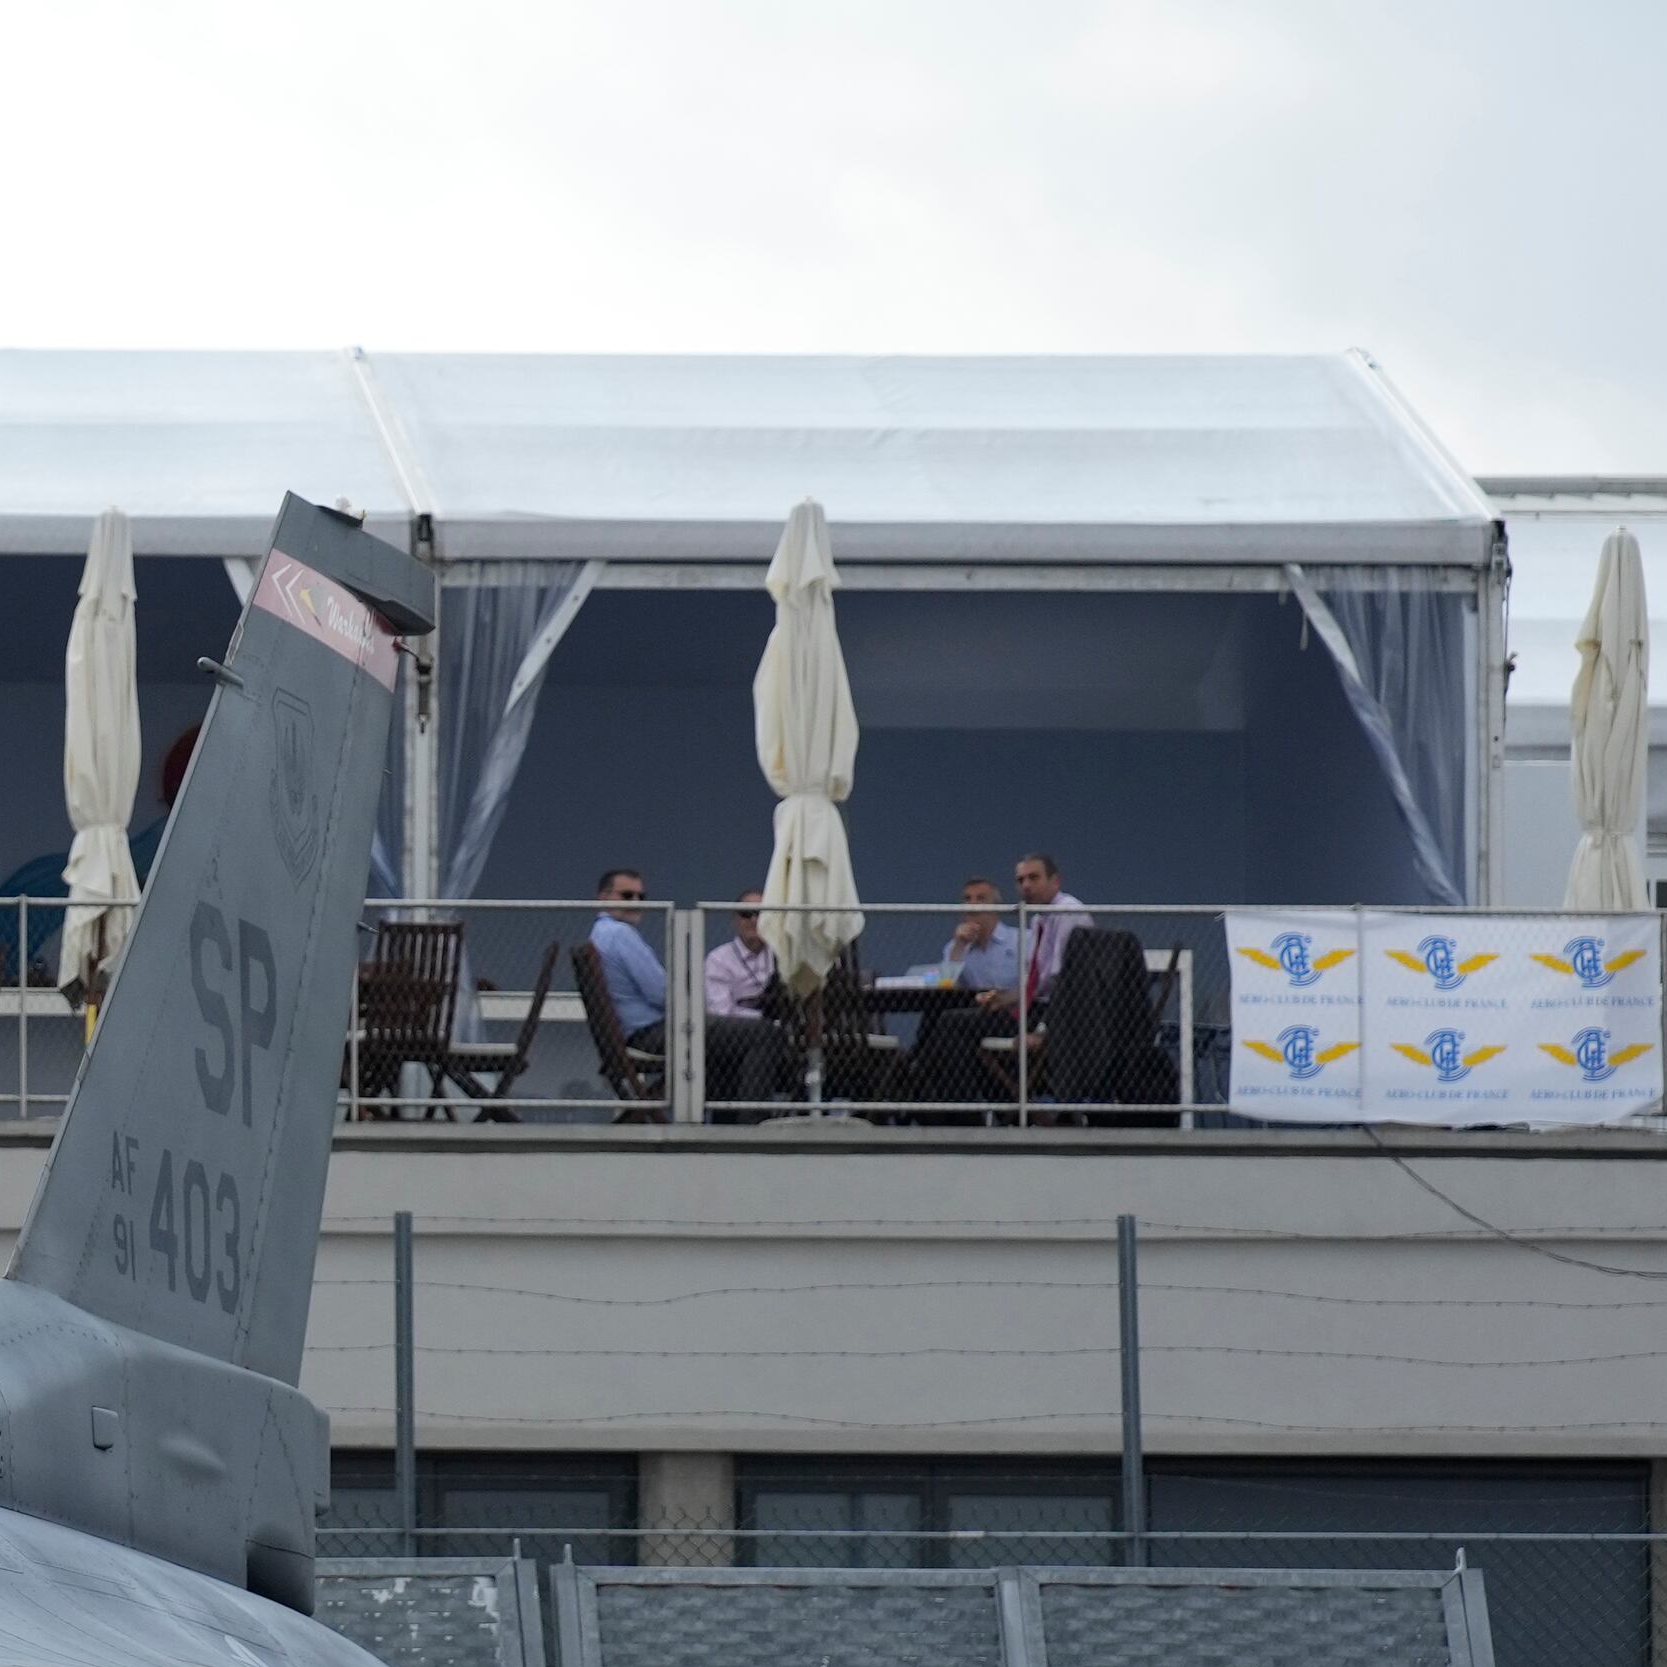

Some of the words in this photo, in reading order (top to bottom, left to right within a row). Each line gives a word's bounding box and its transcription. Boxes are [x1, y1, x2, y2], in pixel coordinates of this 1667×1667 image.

[190, 900, 277, 1128] SP
[111, 1130, 139, 1195] AF
[113, 1213, 137, 1281] 91
[149, 1149, 240, 1316] 403
